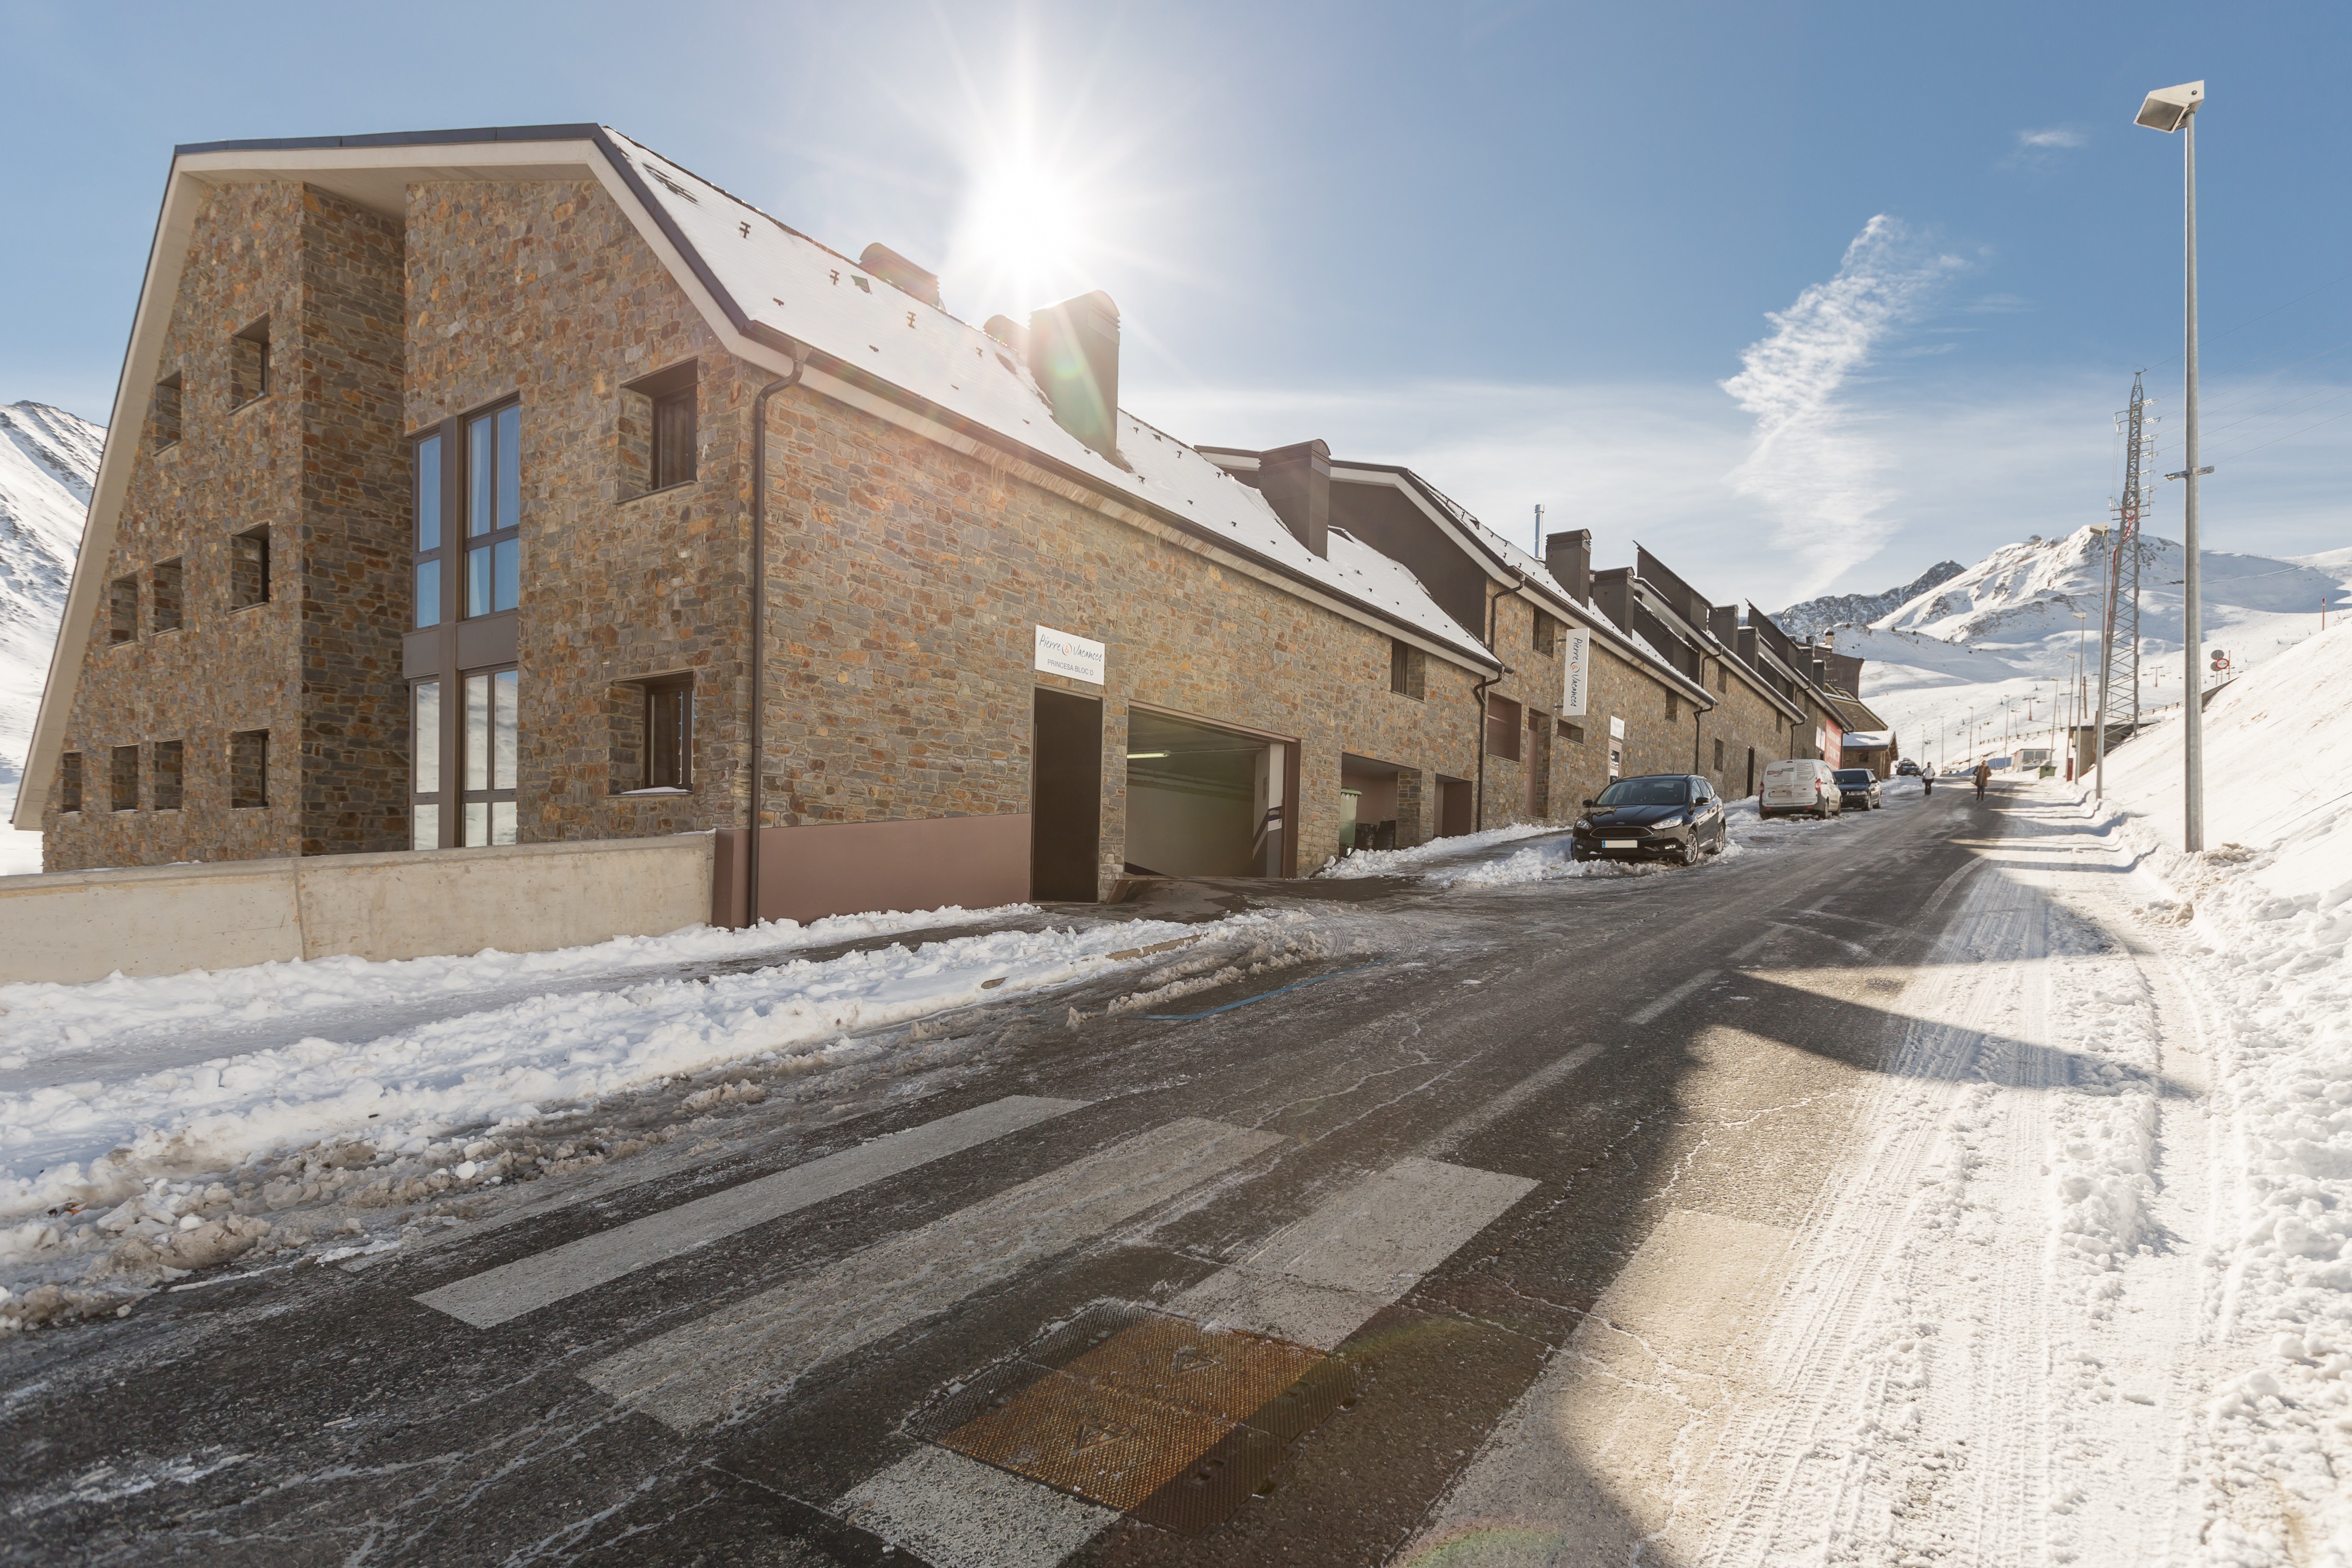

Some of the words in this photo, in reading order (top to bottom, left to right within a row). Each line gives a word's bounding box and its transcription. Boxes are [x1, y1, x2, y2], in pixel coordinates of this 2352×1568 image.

[1039, 634, 1061, 651] Pierre
[1073, 644, 1102, 662] Vacances
[1573, 637, 1583, 661] Pierre
[1047, 659, 1074, 671] PRINCESA
[1075, 666, 1089, 674] BLOC
[1570, 674, 1581, 707] Vacances
